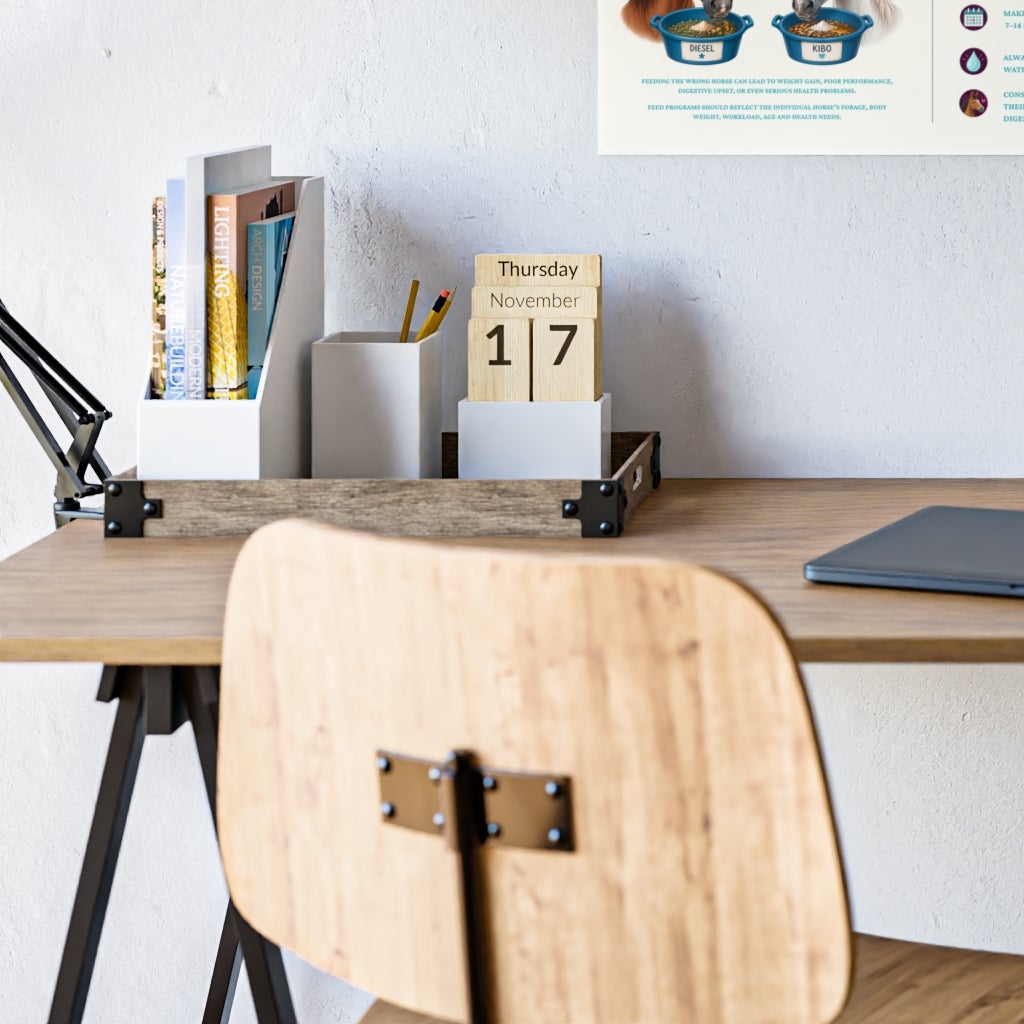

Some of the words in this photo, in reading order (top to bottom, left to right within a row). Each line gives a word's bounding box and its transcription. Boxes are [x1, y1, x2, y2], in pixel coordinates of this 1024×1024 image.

[689, 44, 714, 52] DIESEL
[812, 44, 832, 52] KIBO
[214, 205, 230, 298] LIGHTING
[251, 228, 262, 263] ARCH
[497, 261, 579, 280] Thursday
[251, 265, 262, 311] DESIGN
[490, 292, 581, 308] November
